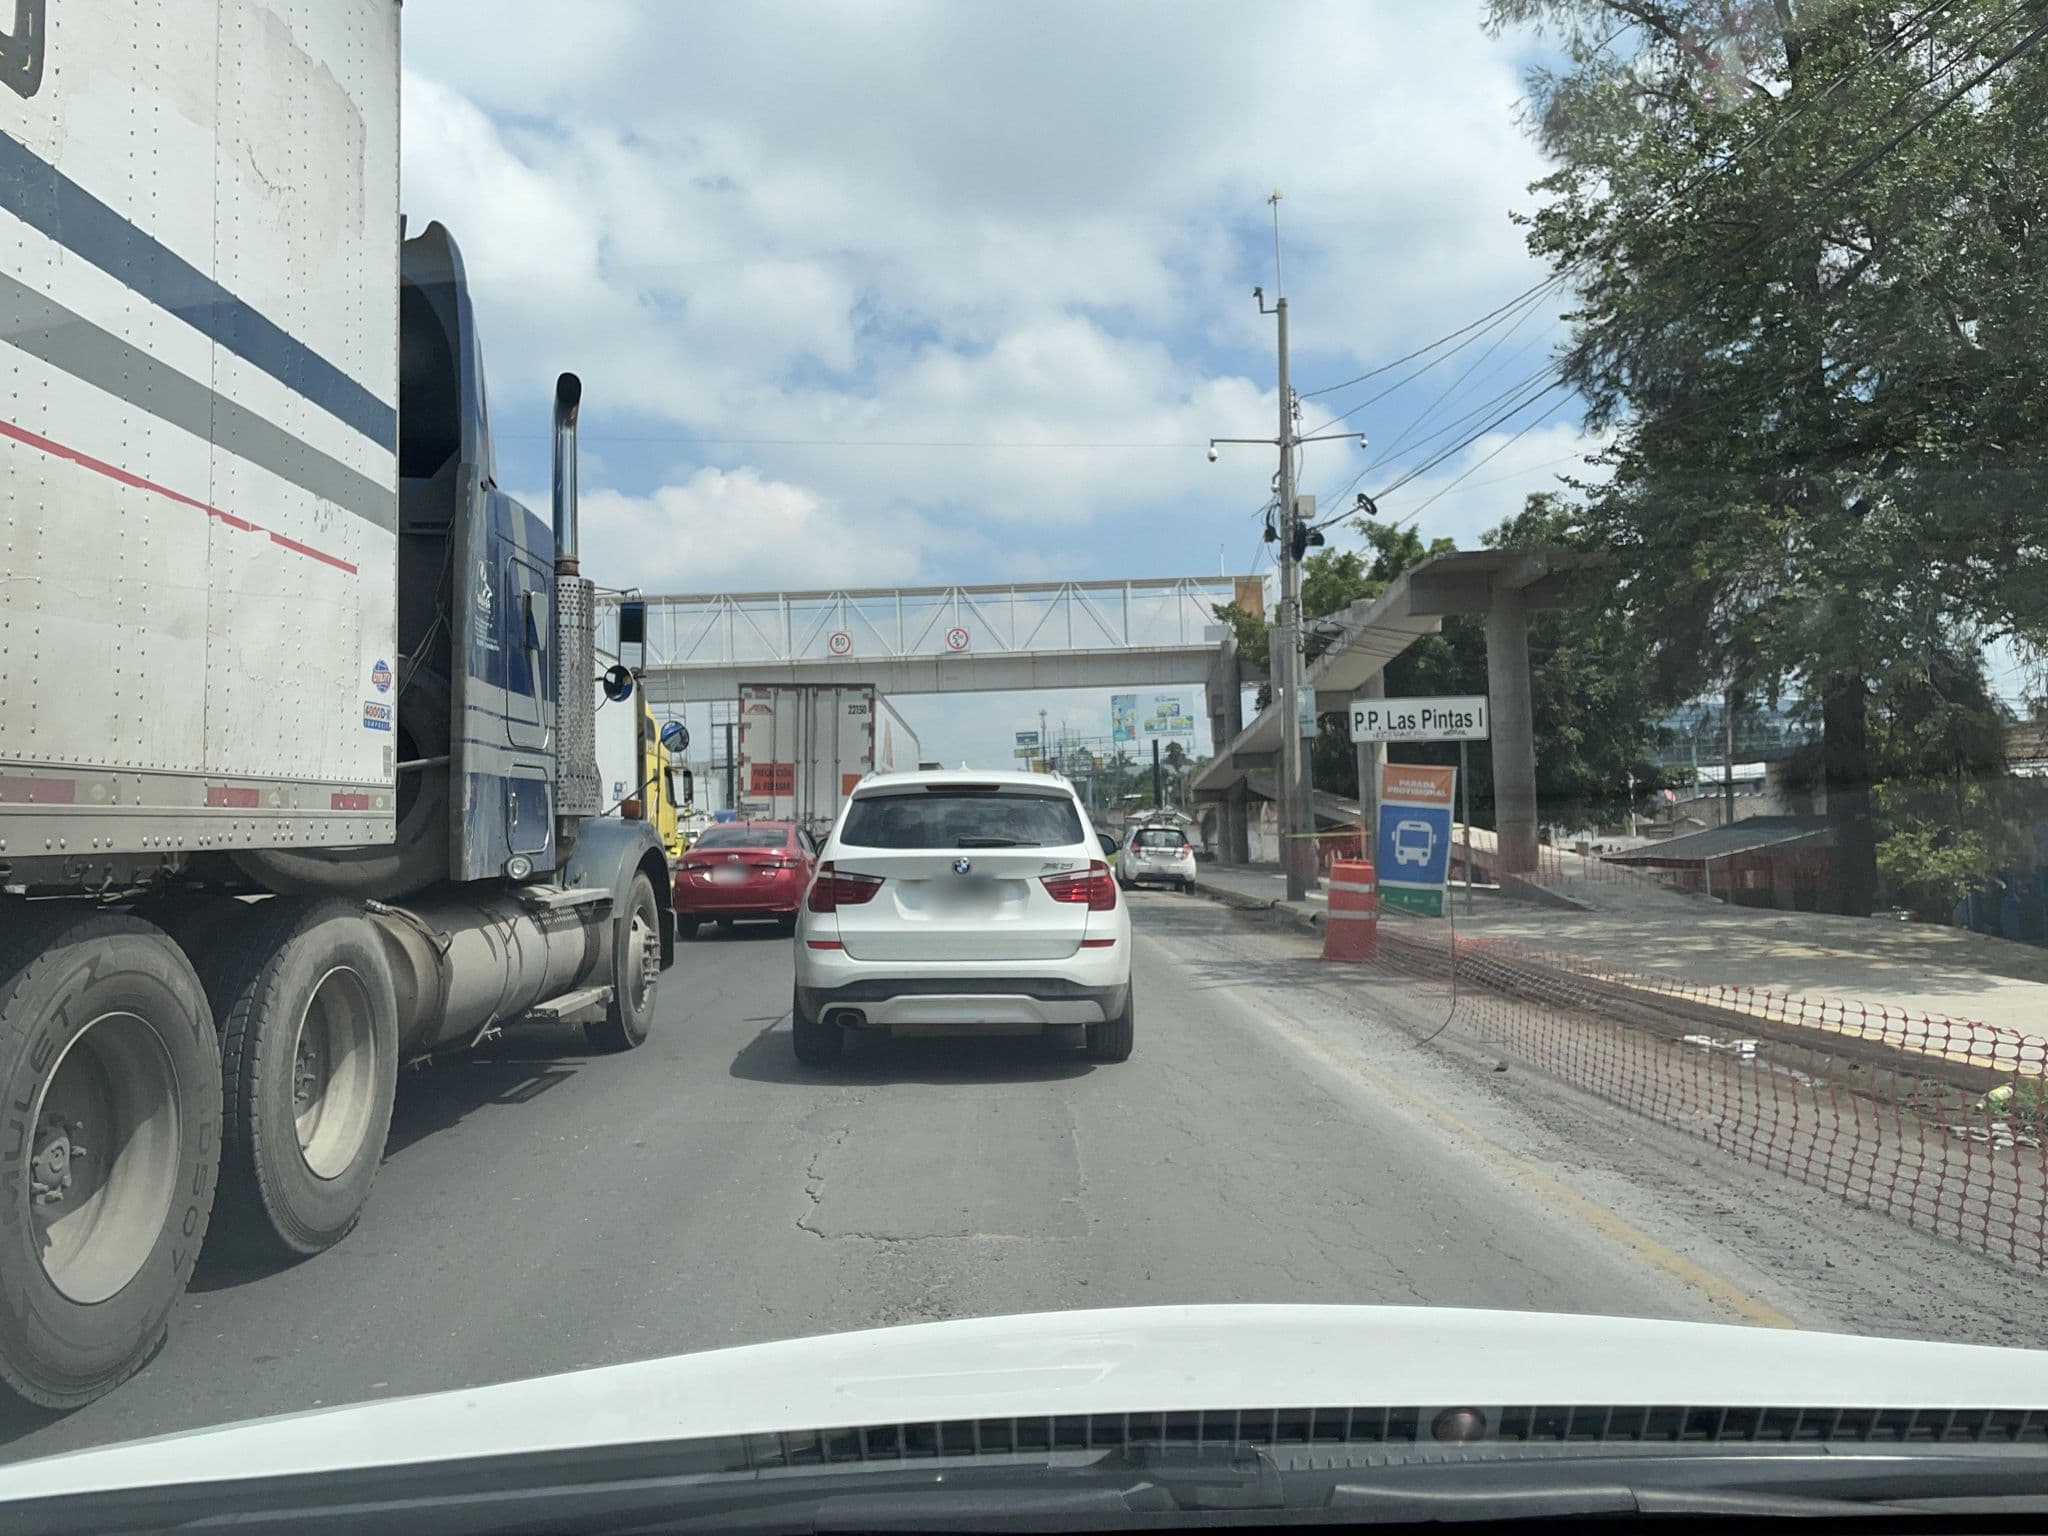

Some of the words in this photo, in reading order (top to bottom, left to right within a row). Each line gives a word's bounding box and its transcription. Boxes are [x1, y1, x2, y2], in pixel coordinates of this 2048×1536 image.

[1354, 711, 1382, 732] P.P.
[1386, 710, 1417, 731] Las
[1421, 708, 1473, 729] Pintas
[1399, 779, 1436, 788] PARADA
[1387, 785, 1447, 797] PROVISIONAL
